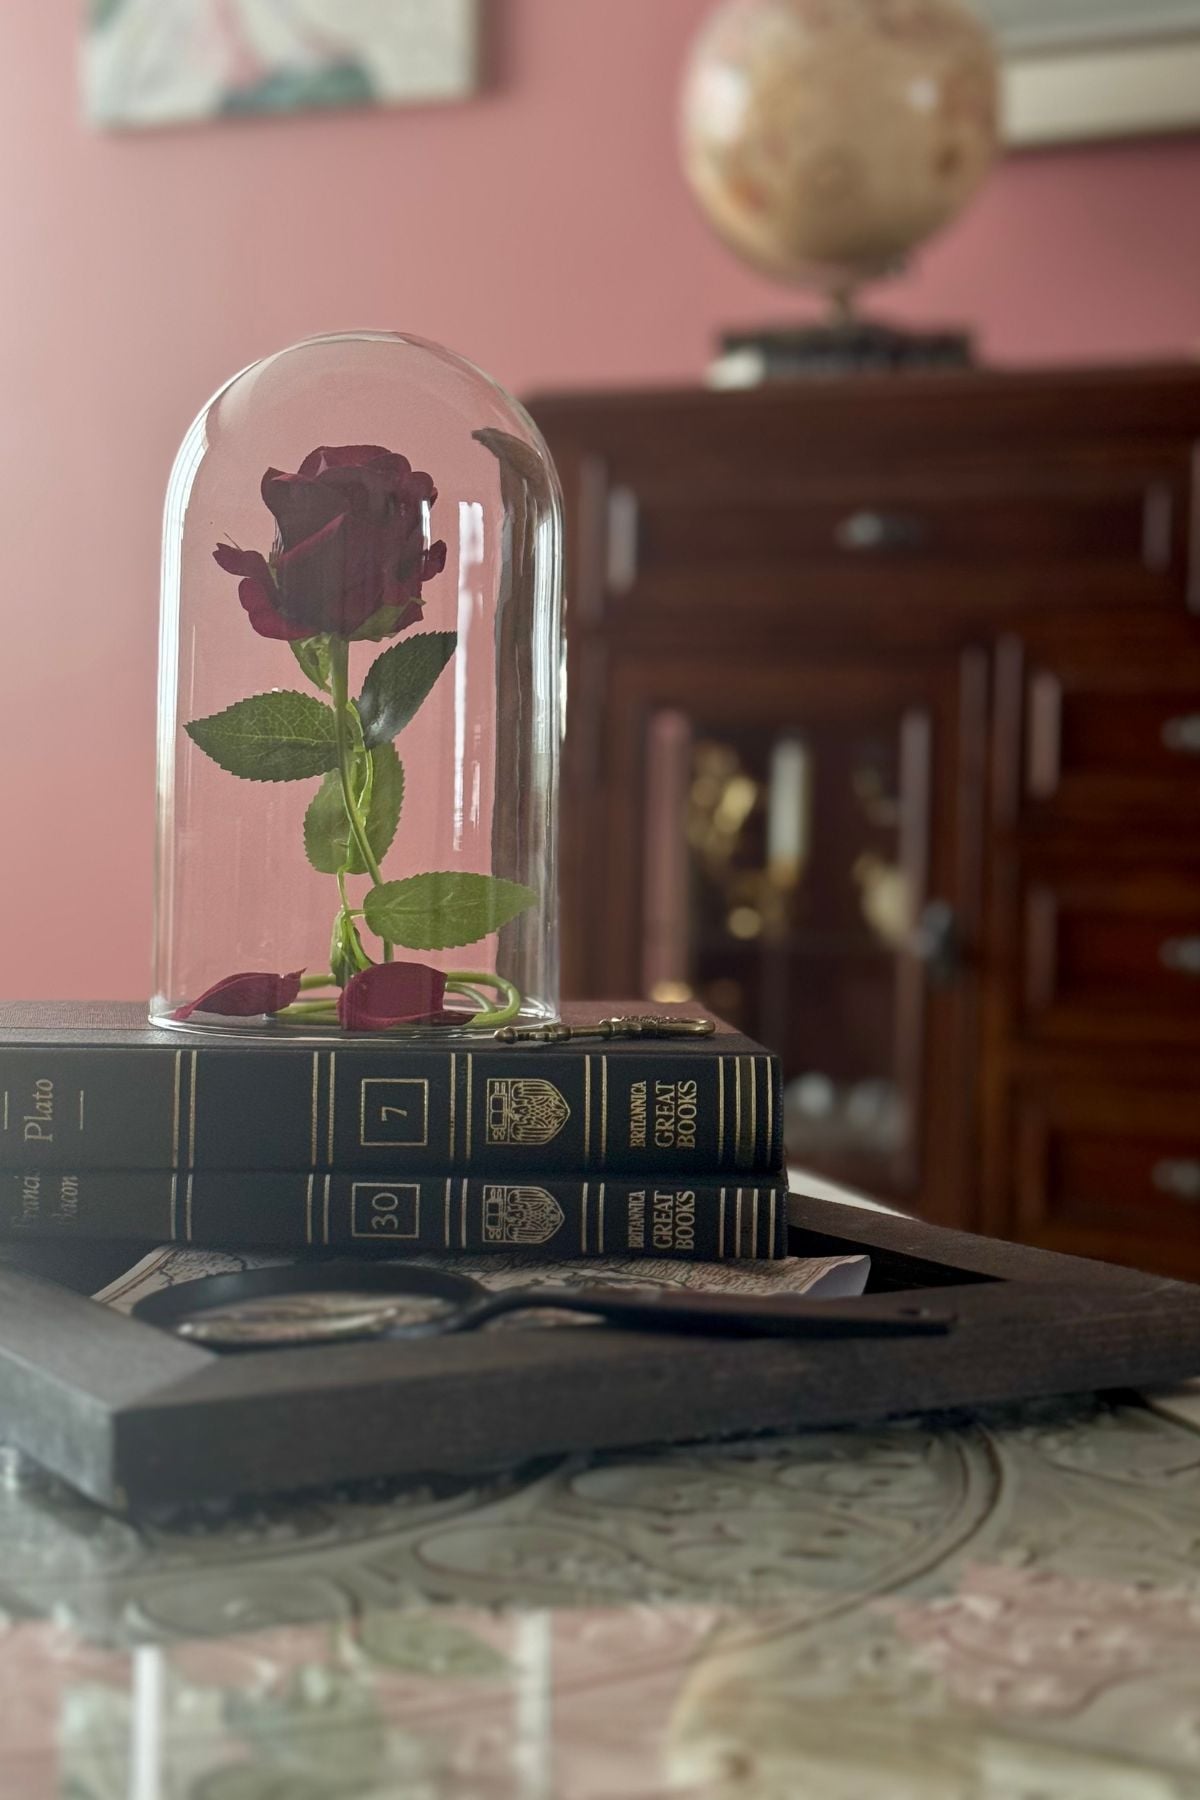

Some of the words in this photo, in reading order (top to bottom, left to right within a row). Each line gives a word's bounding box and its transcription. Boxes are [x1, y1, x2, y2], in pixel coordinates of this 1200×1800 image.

[24, 1078, 54, 1143] Plato
[381, 1106, 408, 1122] 7
[629, 1080, 647, 1148] BRITANNICA
[655, 1080, 675, 1148] GREAT
[676, 1079, 697, 1149] BOOKS
[371, 1192, 399, 1231] 30
[628, 1190, 646, 1249] BRITANNICA
[653, 1190, 675, 1250] GREAT
[676, 1190, 696, 1251] BOOKS
